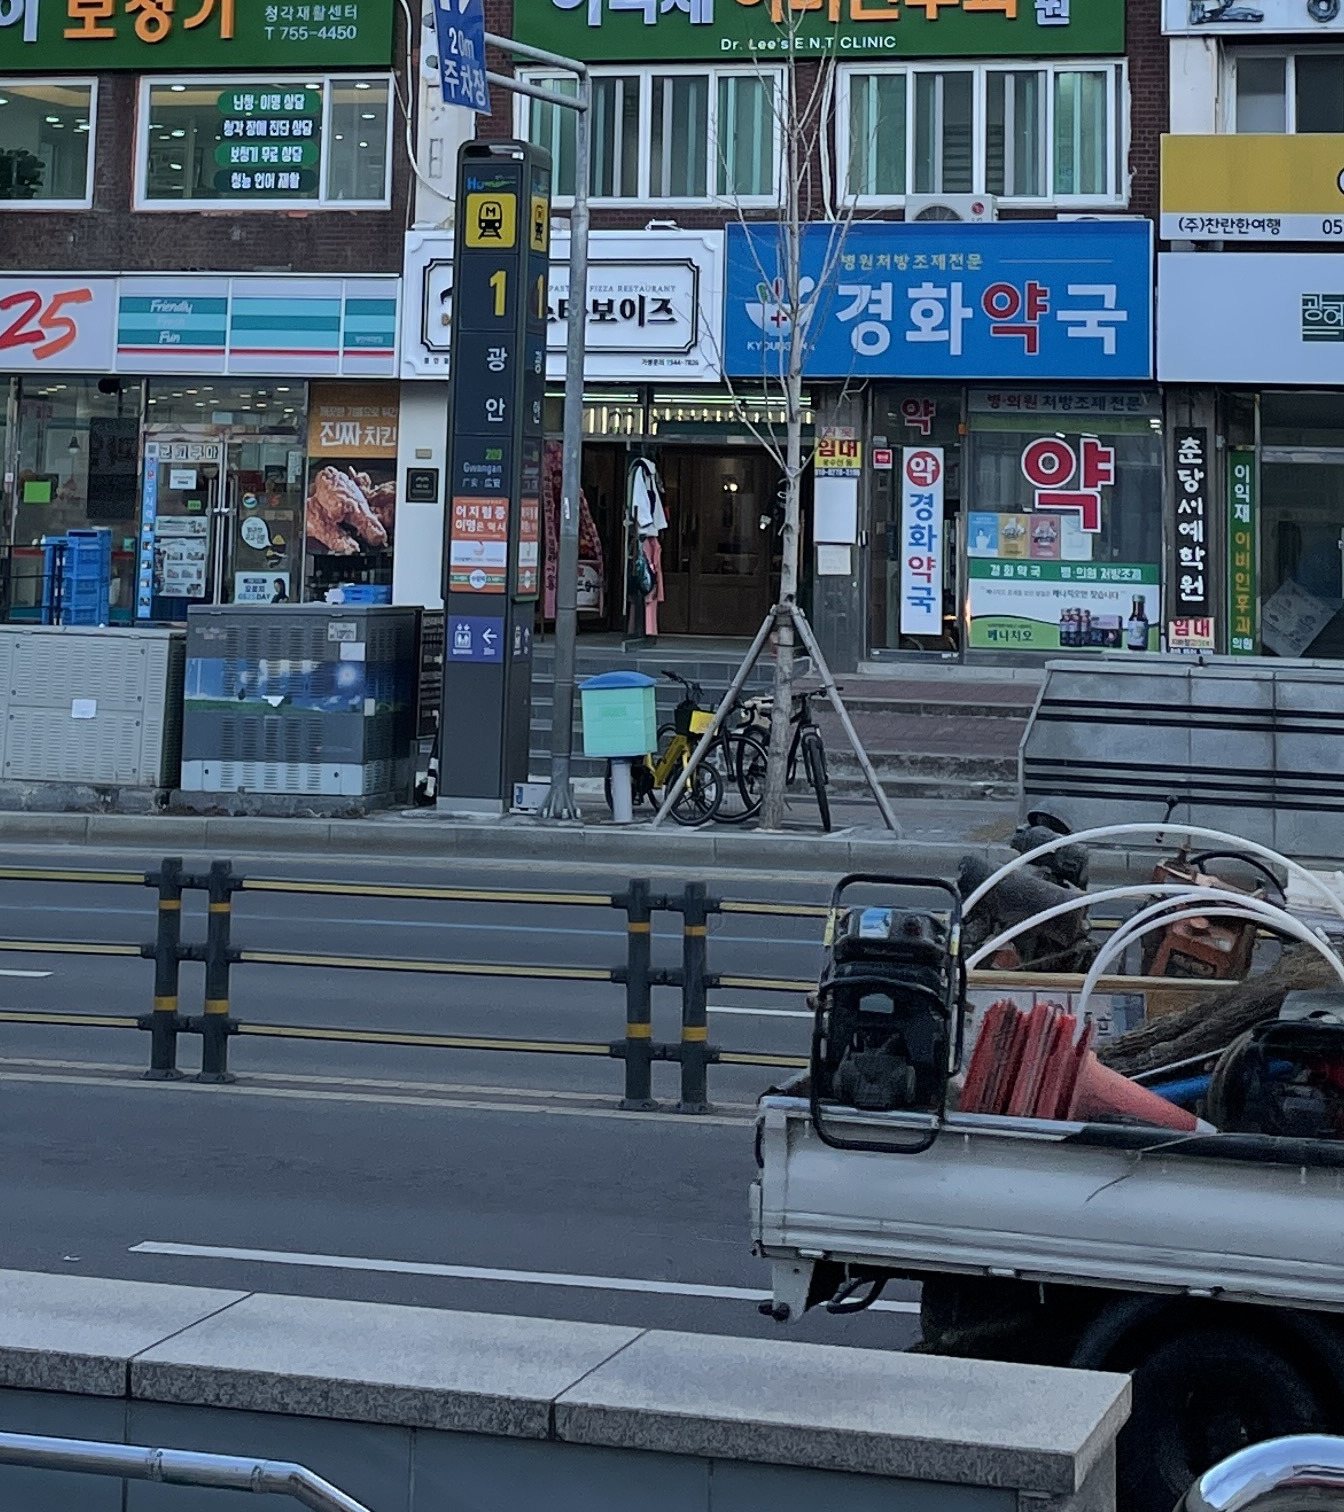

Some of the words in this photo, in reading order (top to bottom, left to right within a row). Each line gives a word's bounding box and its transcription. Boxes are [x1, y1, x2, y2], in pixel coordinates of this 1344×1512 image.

[264, 4, 358, 23] 청각재활센터
[264, 26, 275, 40] T
[279, 25, 357, 41] 755-4450
[839, 36, 897, 49] CLINIC
[444, 58, 486, 107] 주차장
[284, 93, 305, 110] 상담
[292, 119, 313, 137] 상담
[230, 146, 258, 163] 보청기
[261, 146, 278, 163] 무료
[281, 146, 303, 163] 상담
[1177, 217, 1282, 236] (주)찬란한여행
[488, 268, 507, 318] 1
[149, 298, 194, 315] Friendly
[834, 279, 1128, 357] 경화약국
[158, 330, 181, 344] Fun
[485, 347, 508, 422] 광안
[901, 397, 937, 436] 약
[319, 421, 363, 447] 진짜
[364, 425, 396, 447] 치킨
[818, 439, 858, 458] 임대
[463, 461, 502, 476] Gwangan
[908, 452, 937, 486] 약
[1021, 436, 1115, 534] 약
[1233, 464, 1251, 524] 이익재
[1177, 436, 1206, 603] 춘당서예학원
[906, 491, 938, 615] 경화약국
[989, 563, 1041, 578] 경화약국
[1234, 531, 1252, 637] 이비인후과
[1172, 618, 1211, 638] 임대
[1232, 637, 1254, 651] 의원
